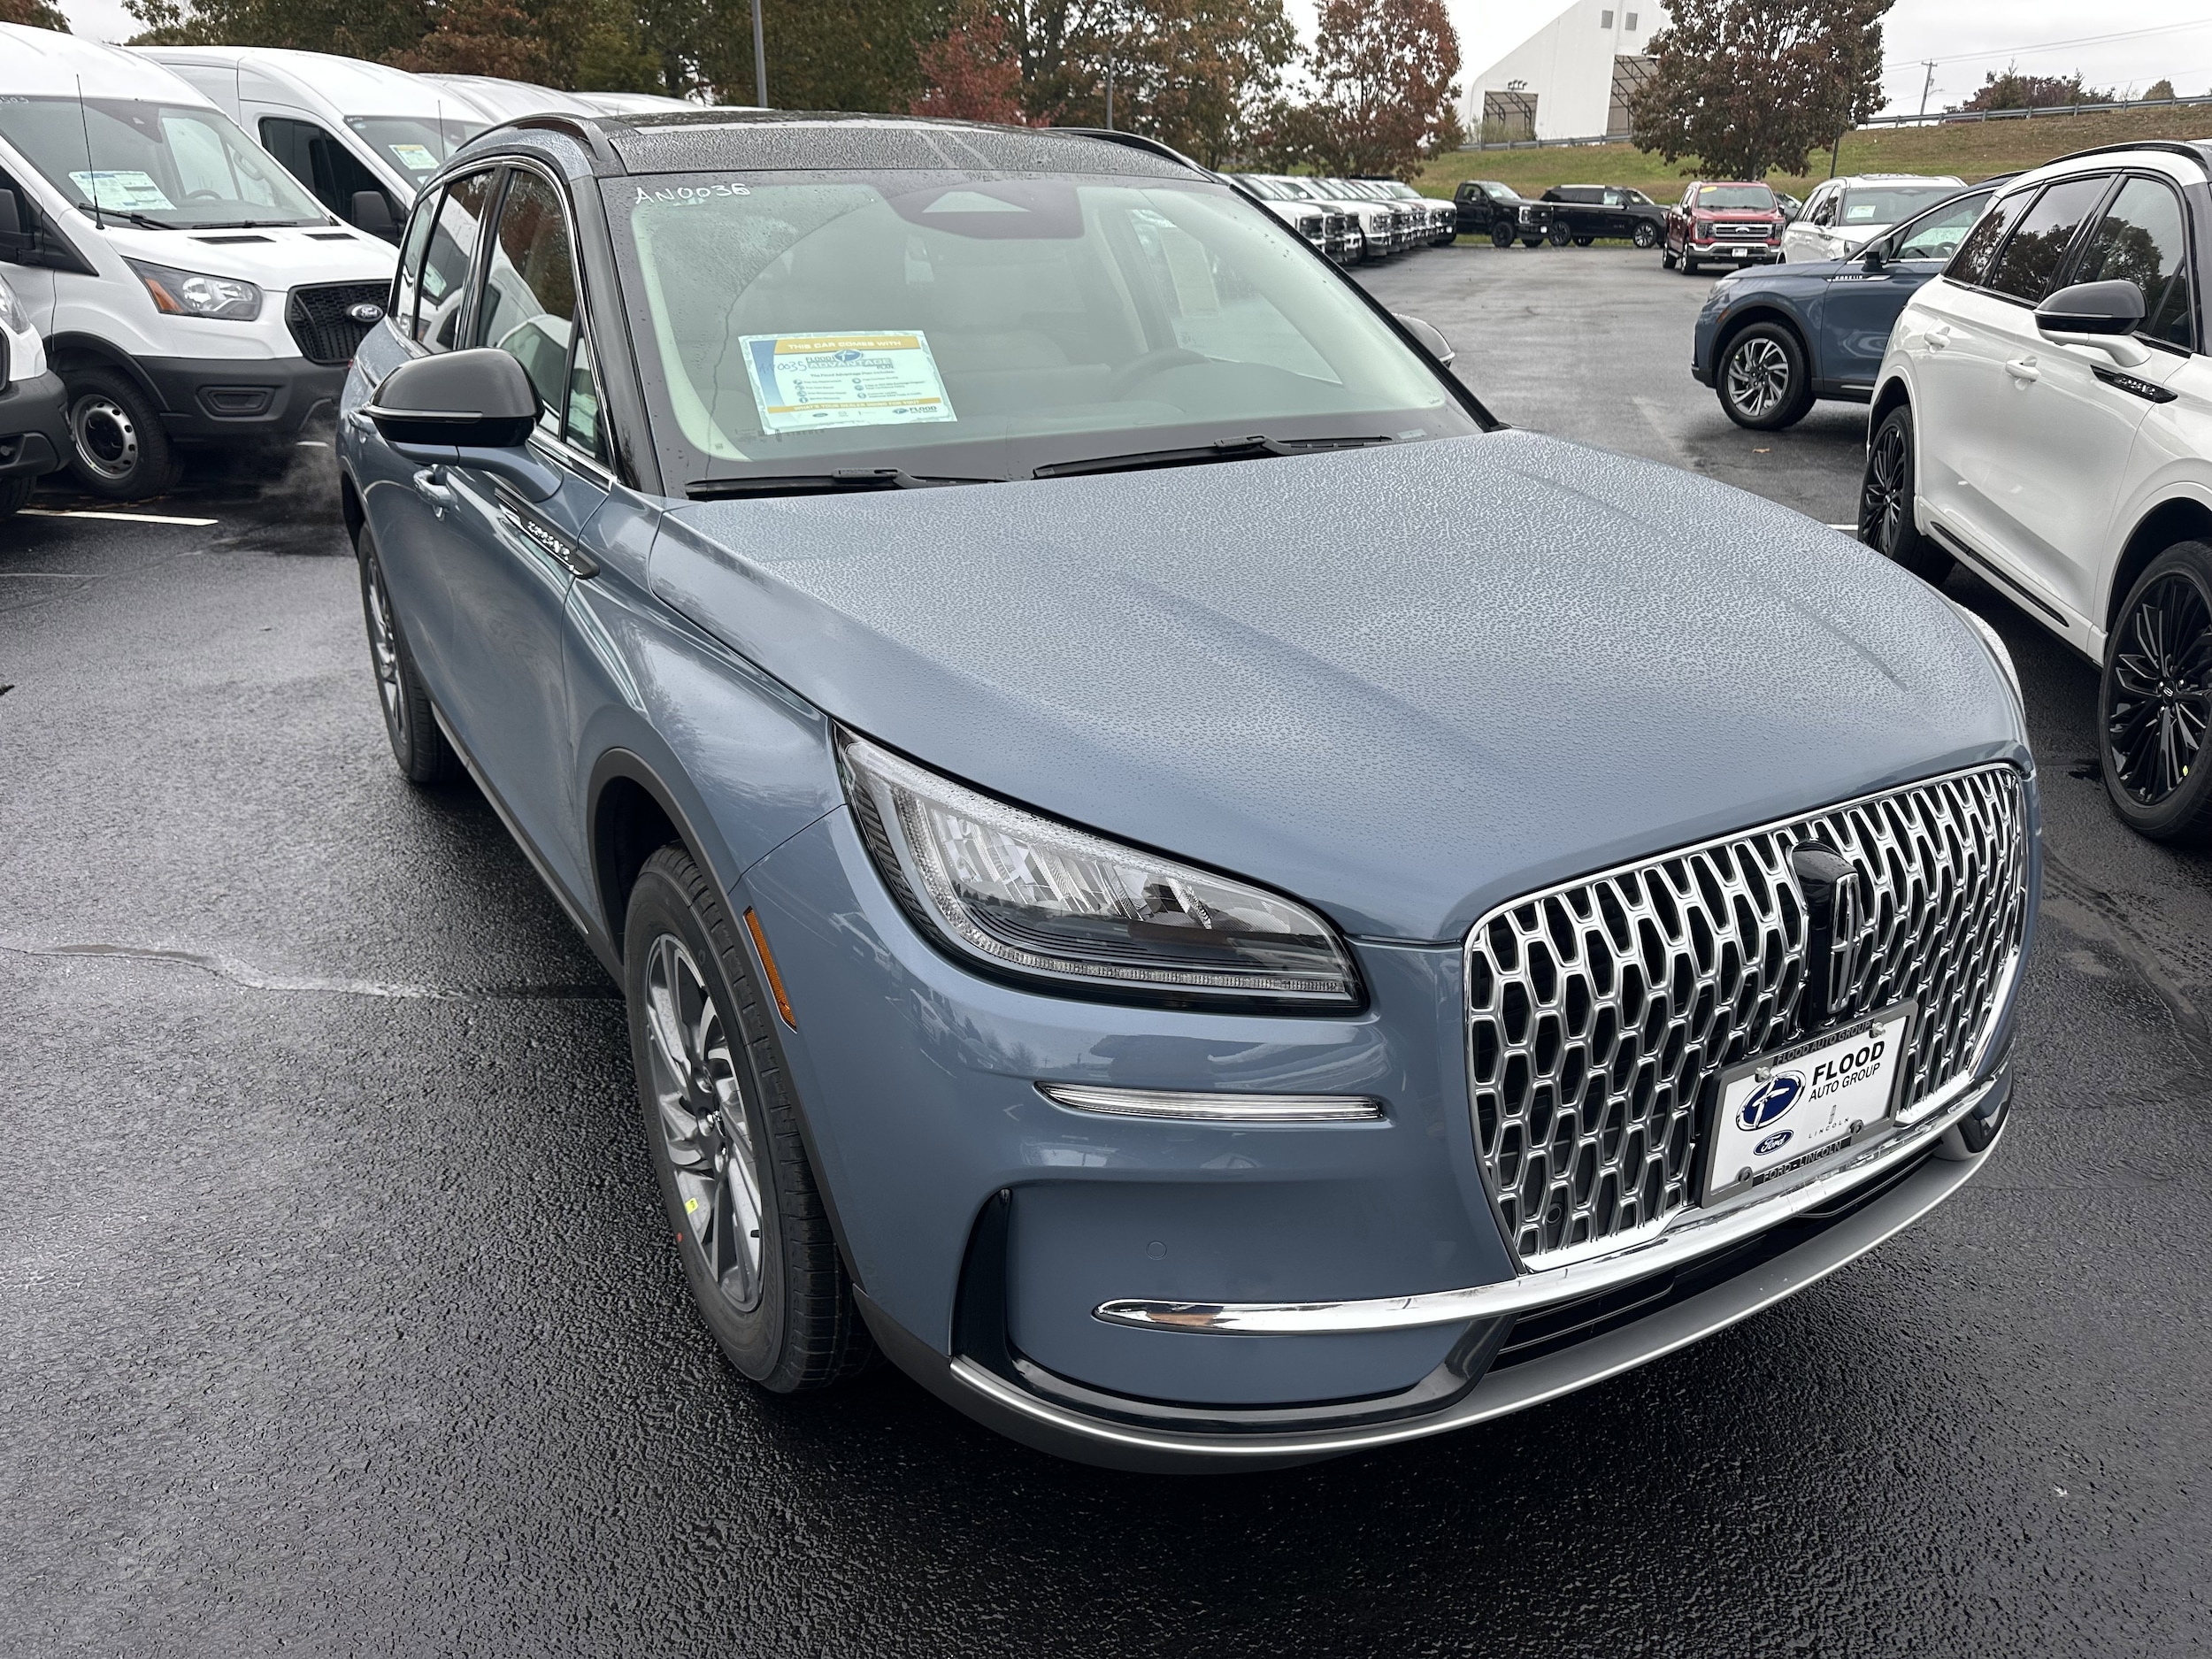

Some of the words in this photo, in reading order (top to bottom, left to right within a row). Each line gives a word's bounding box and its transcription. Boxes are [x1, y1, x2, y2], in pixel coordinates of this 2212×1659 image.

[809, 359, 891, 368] ADVANTAGE
[1777, 1044, 1810, 1065] FLOOD
[1809, 1034, 1838, 1053] AUTO
[1838, 1021, 1871, 1041] GROUP
[1809, 1080, 1839, 1102] AUTO
[1841, 1062, 1881, 1089] GROUP
[1812, 1040, 1886, 1087] FLOOD
[1761, 1133, 1787, 1153] Ford
[1809, 1117, 1849, 1139] LINCOLN
[1763, 1162, 1792, 1182] FORD
[1799, 1141, 1842, 1166] LINCOLN
